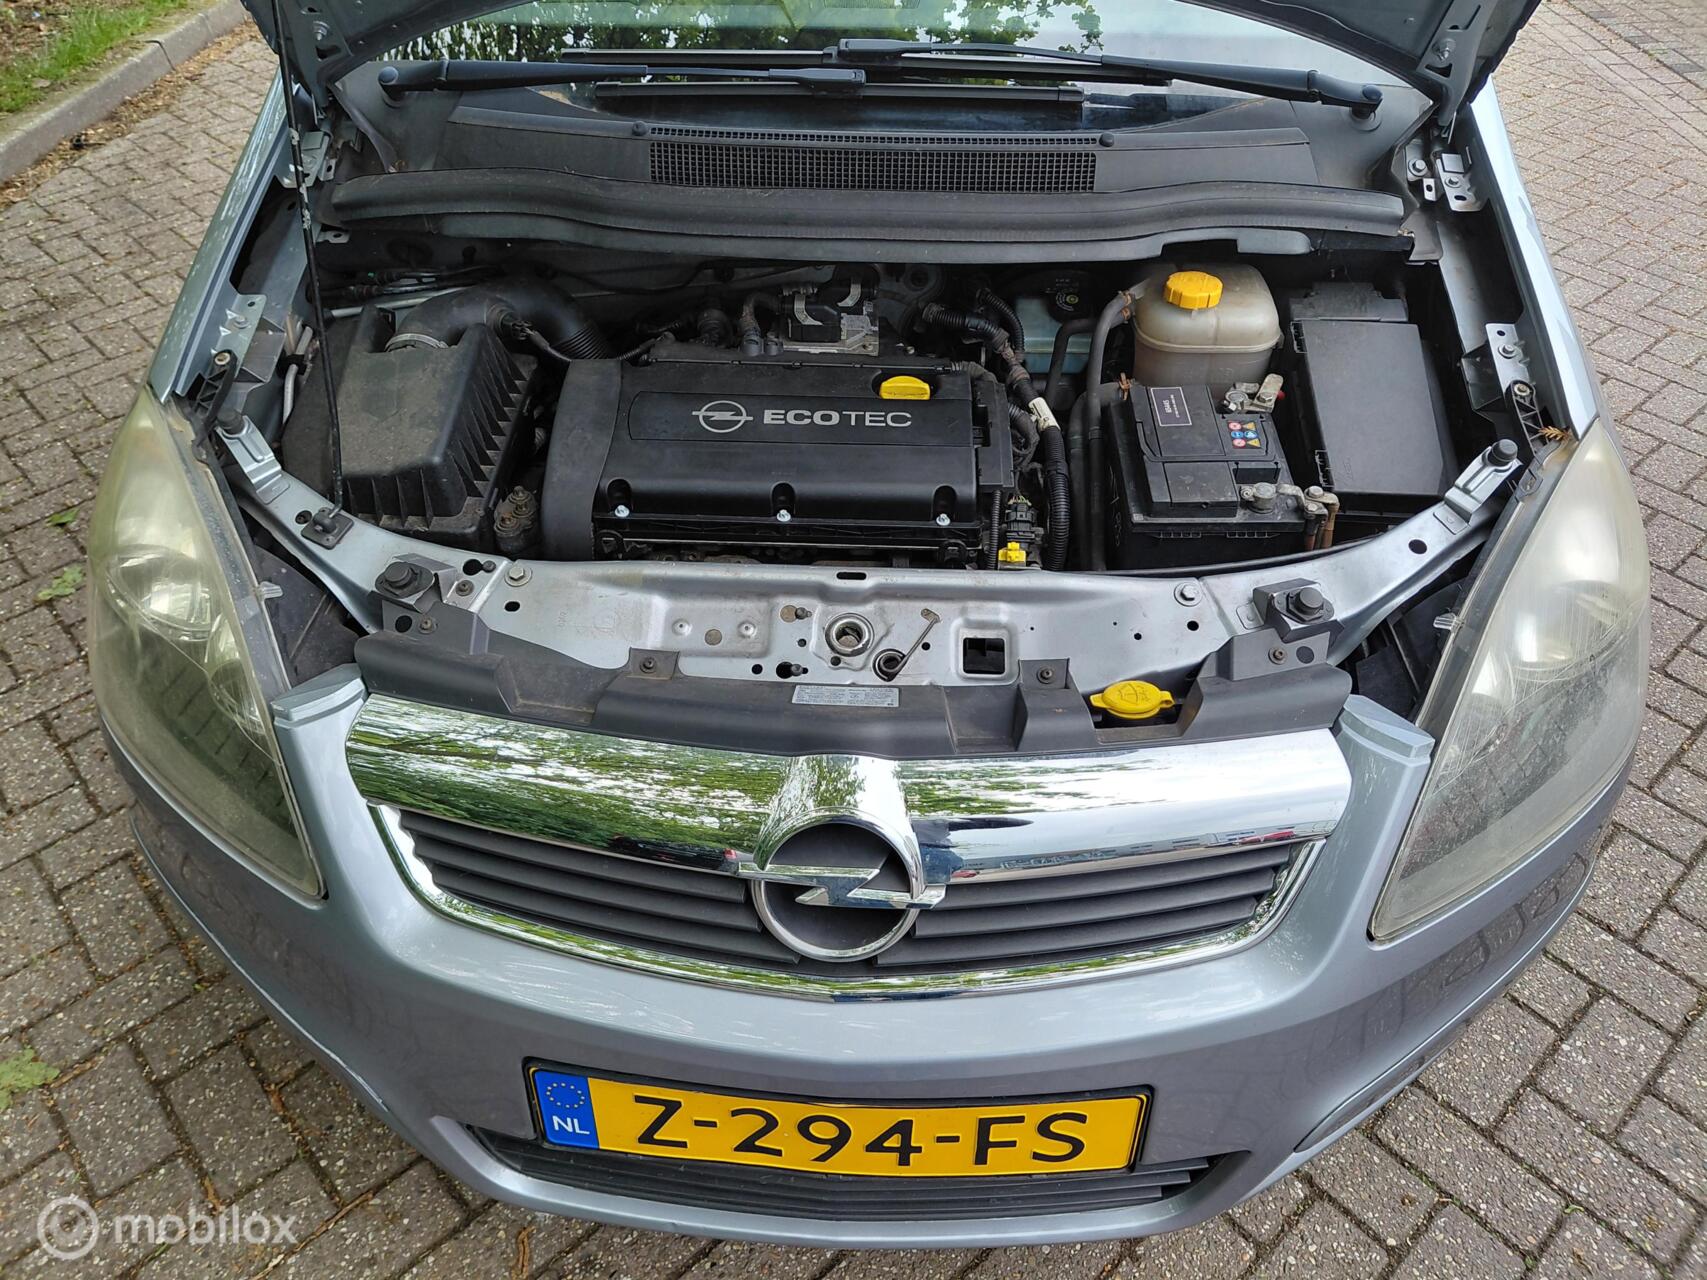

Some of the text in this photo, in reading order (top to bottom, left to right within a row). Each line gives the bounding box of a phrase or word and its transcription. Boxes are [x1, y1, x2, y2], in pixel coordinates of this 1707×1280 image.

[763, 409, 912, 427] ECOTEC
[552, 1115, 590, 1135] NL
[633, 1094, 1088, 1167] Z-294-FS
